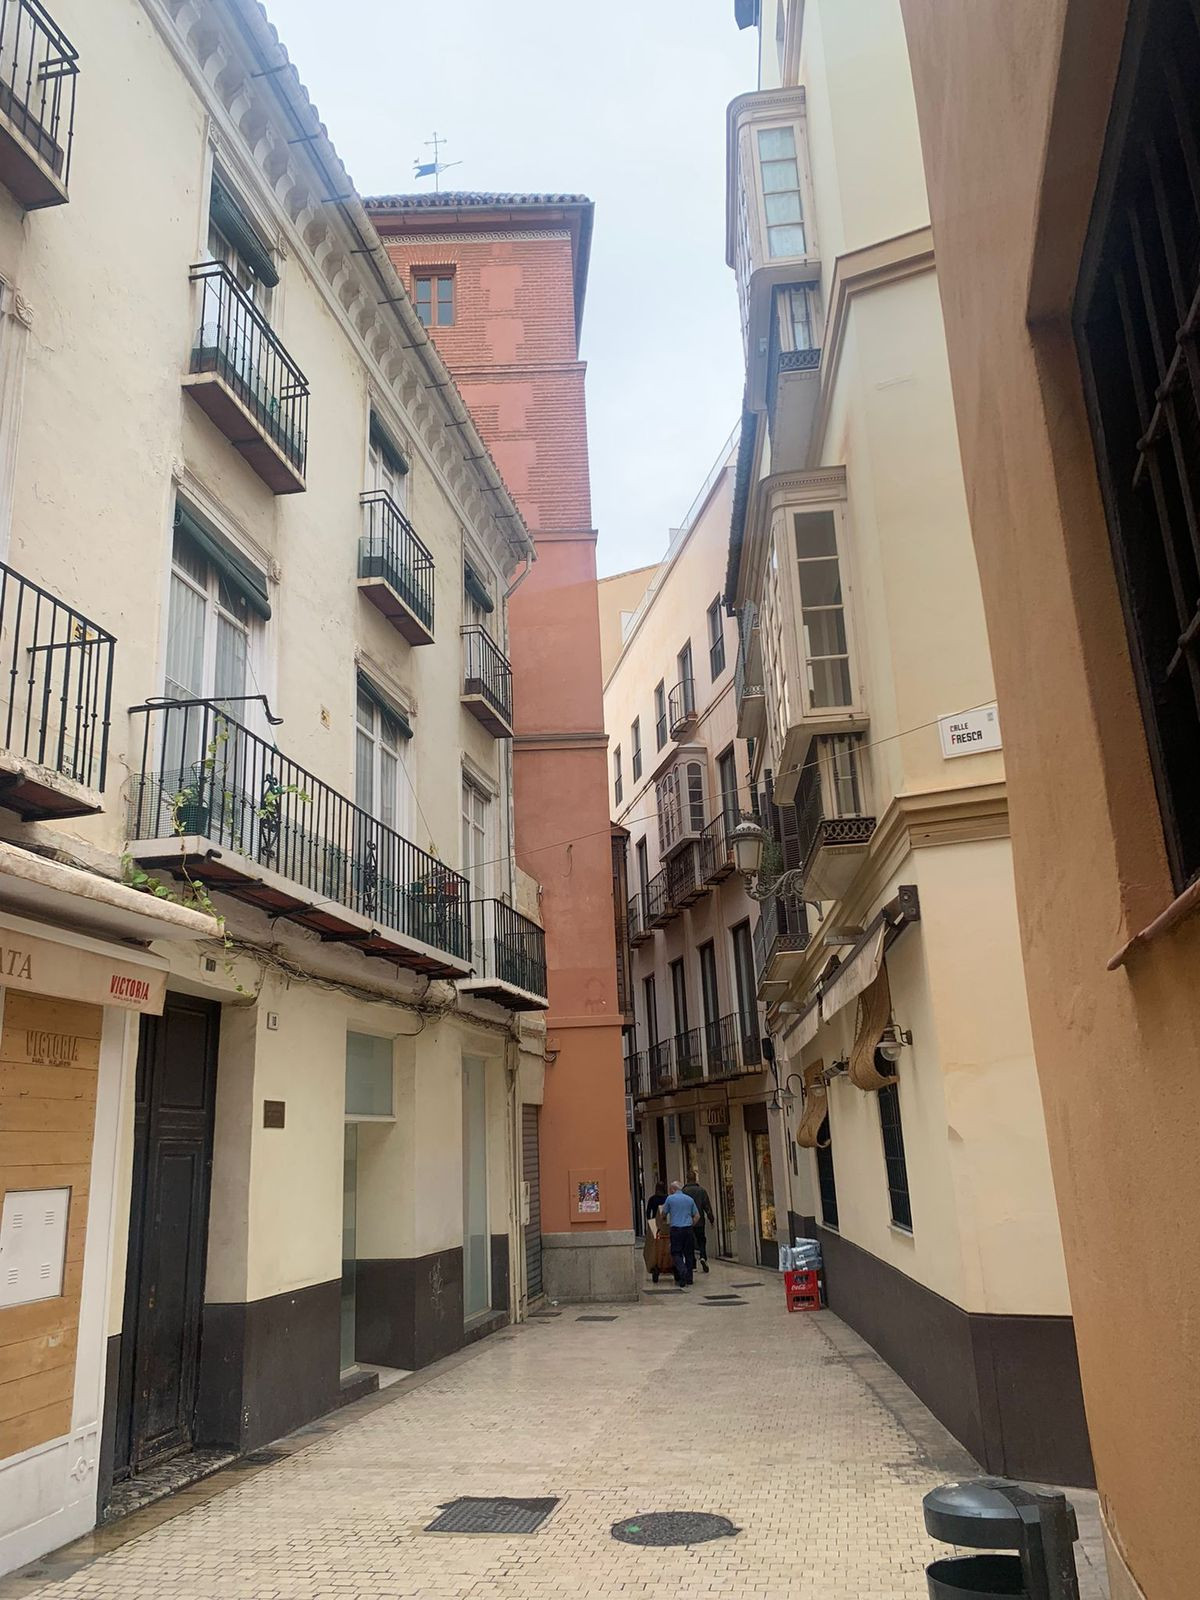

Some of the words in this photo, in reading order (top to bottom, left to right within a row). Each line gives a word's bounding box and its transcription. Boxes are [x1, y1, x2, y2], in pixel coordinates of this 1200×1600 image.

[950, 722, 968, 732] CALLE
[951, 730, 983, 745] FRESCA
[110, 975, 149, 1000] VICTORIA
[26, 1031, 79, 1061] VICTORIA
